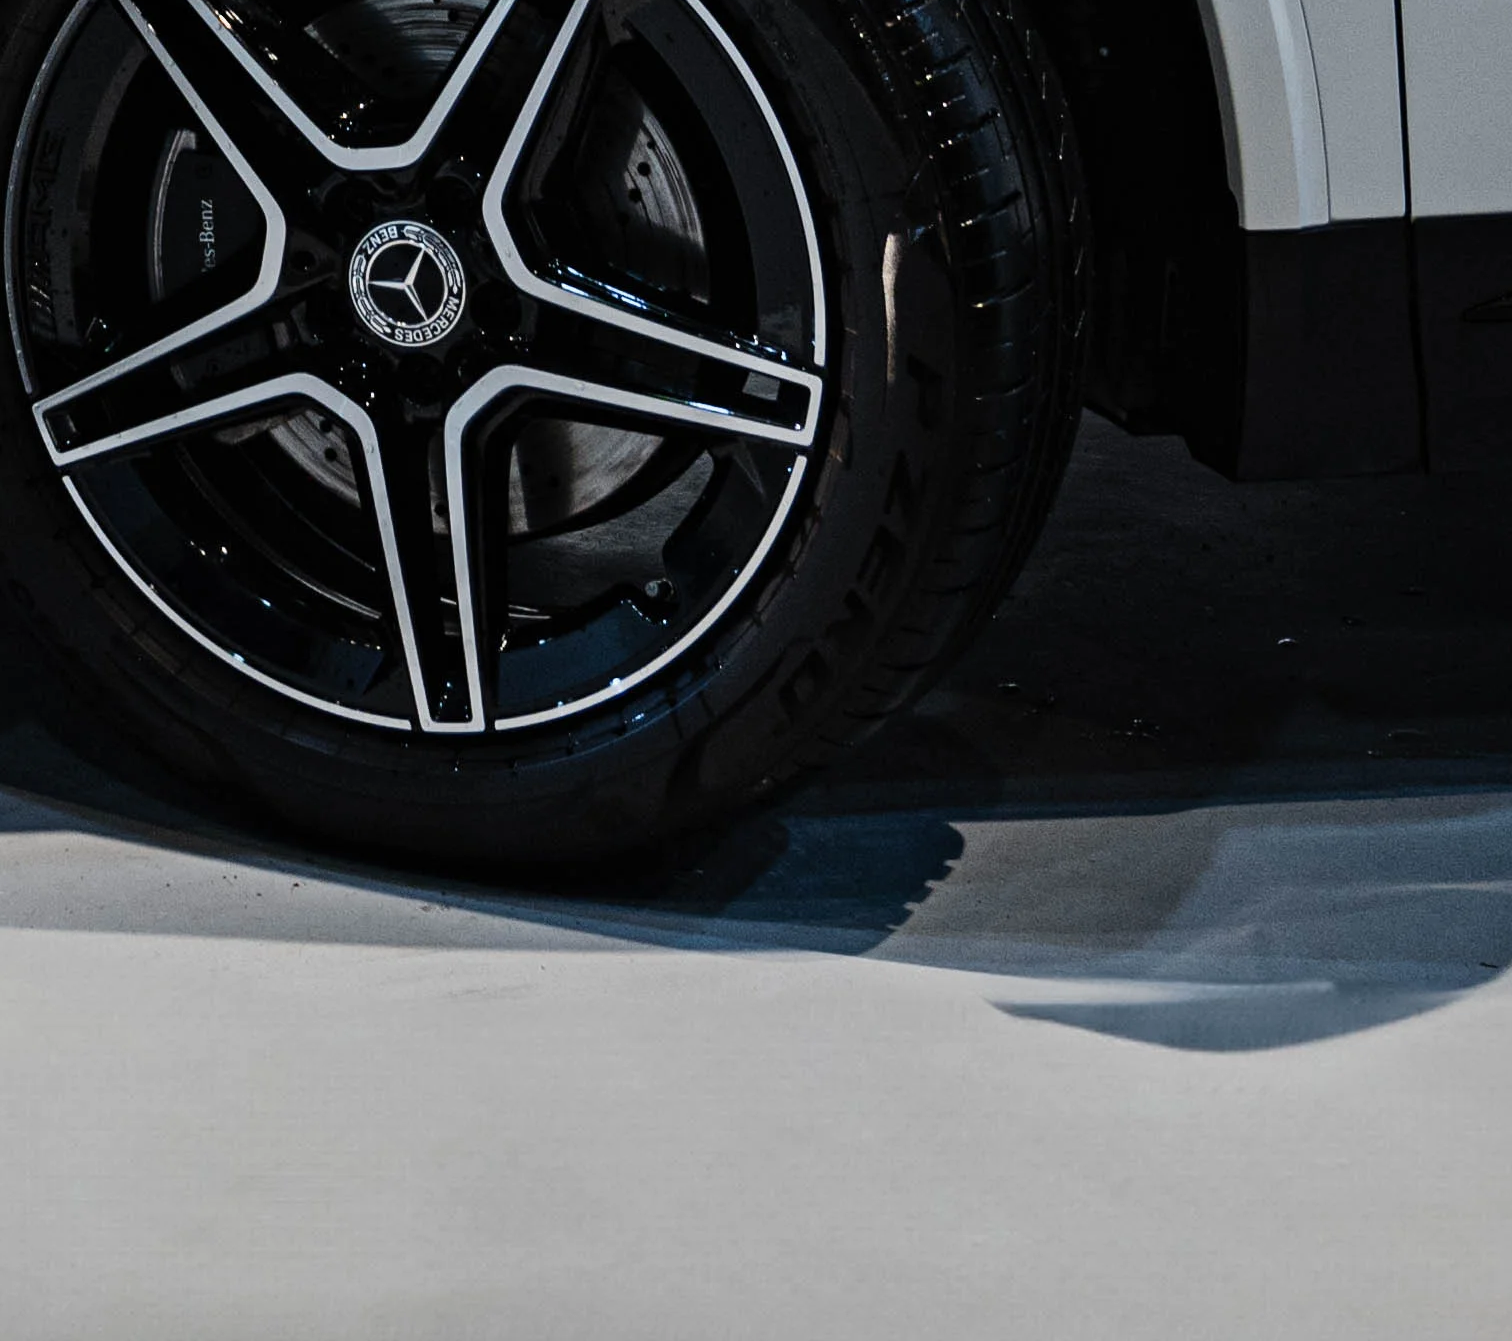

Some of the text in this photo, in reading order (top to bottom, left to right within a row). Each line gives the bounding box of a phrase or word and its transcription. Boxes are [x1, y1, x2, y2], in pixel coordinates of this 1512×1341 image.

[199, 198, 216, 272] es-Benz
[362, 224, 399, 256] BENZ
[393, 295, 461, 343] MERCEDES
